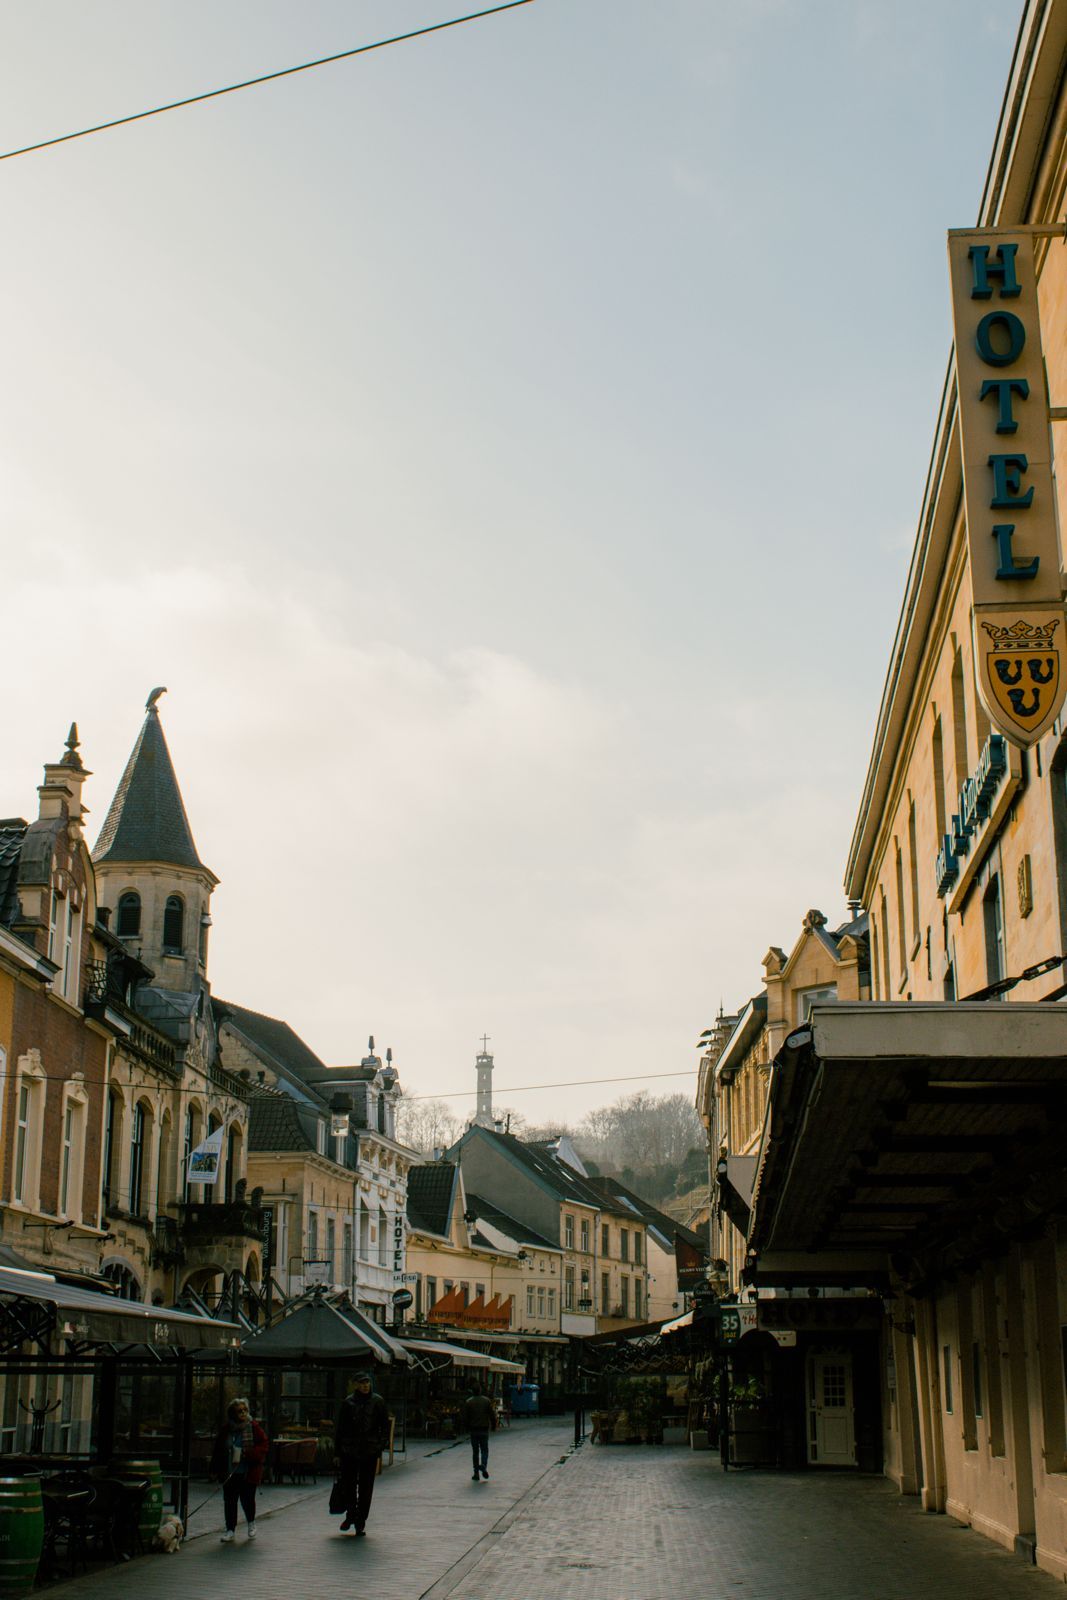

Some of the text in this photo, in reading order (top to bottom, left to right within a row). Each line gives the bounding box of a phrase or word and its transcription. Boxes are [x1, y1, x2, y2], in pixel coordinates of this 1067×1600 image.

[969, 243, 1040, 580] HOTEL
[394, 1216, 402, 1271] HOTEL
[722, 1315, 738, 1329] 35
